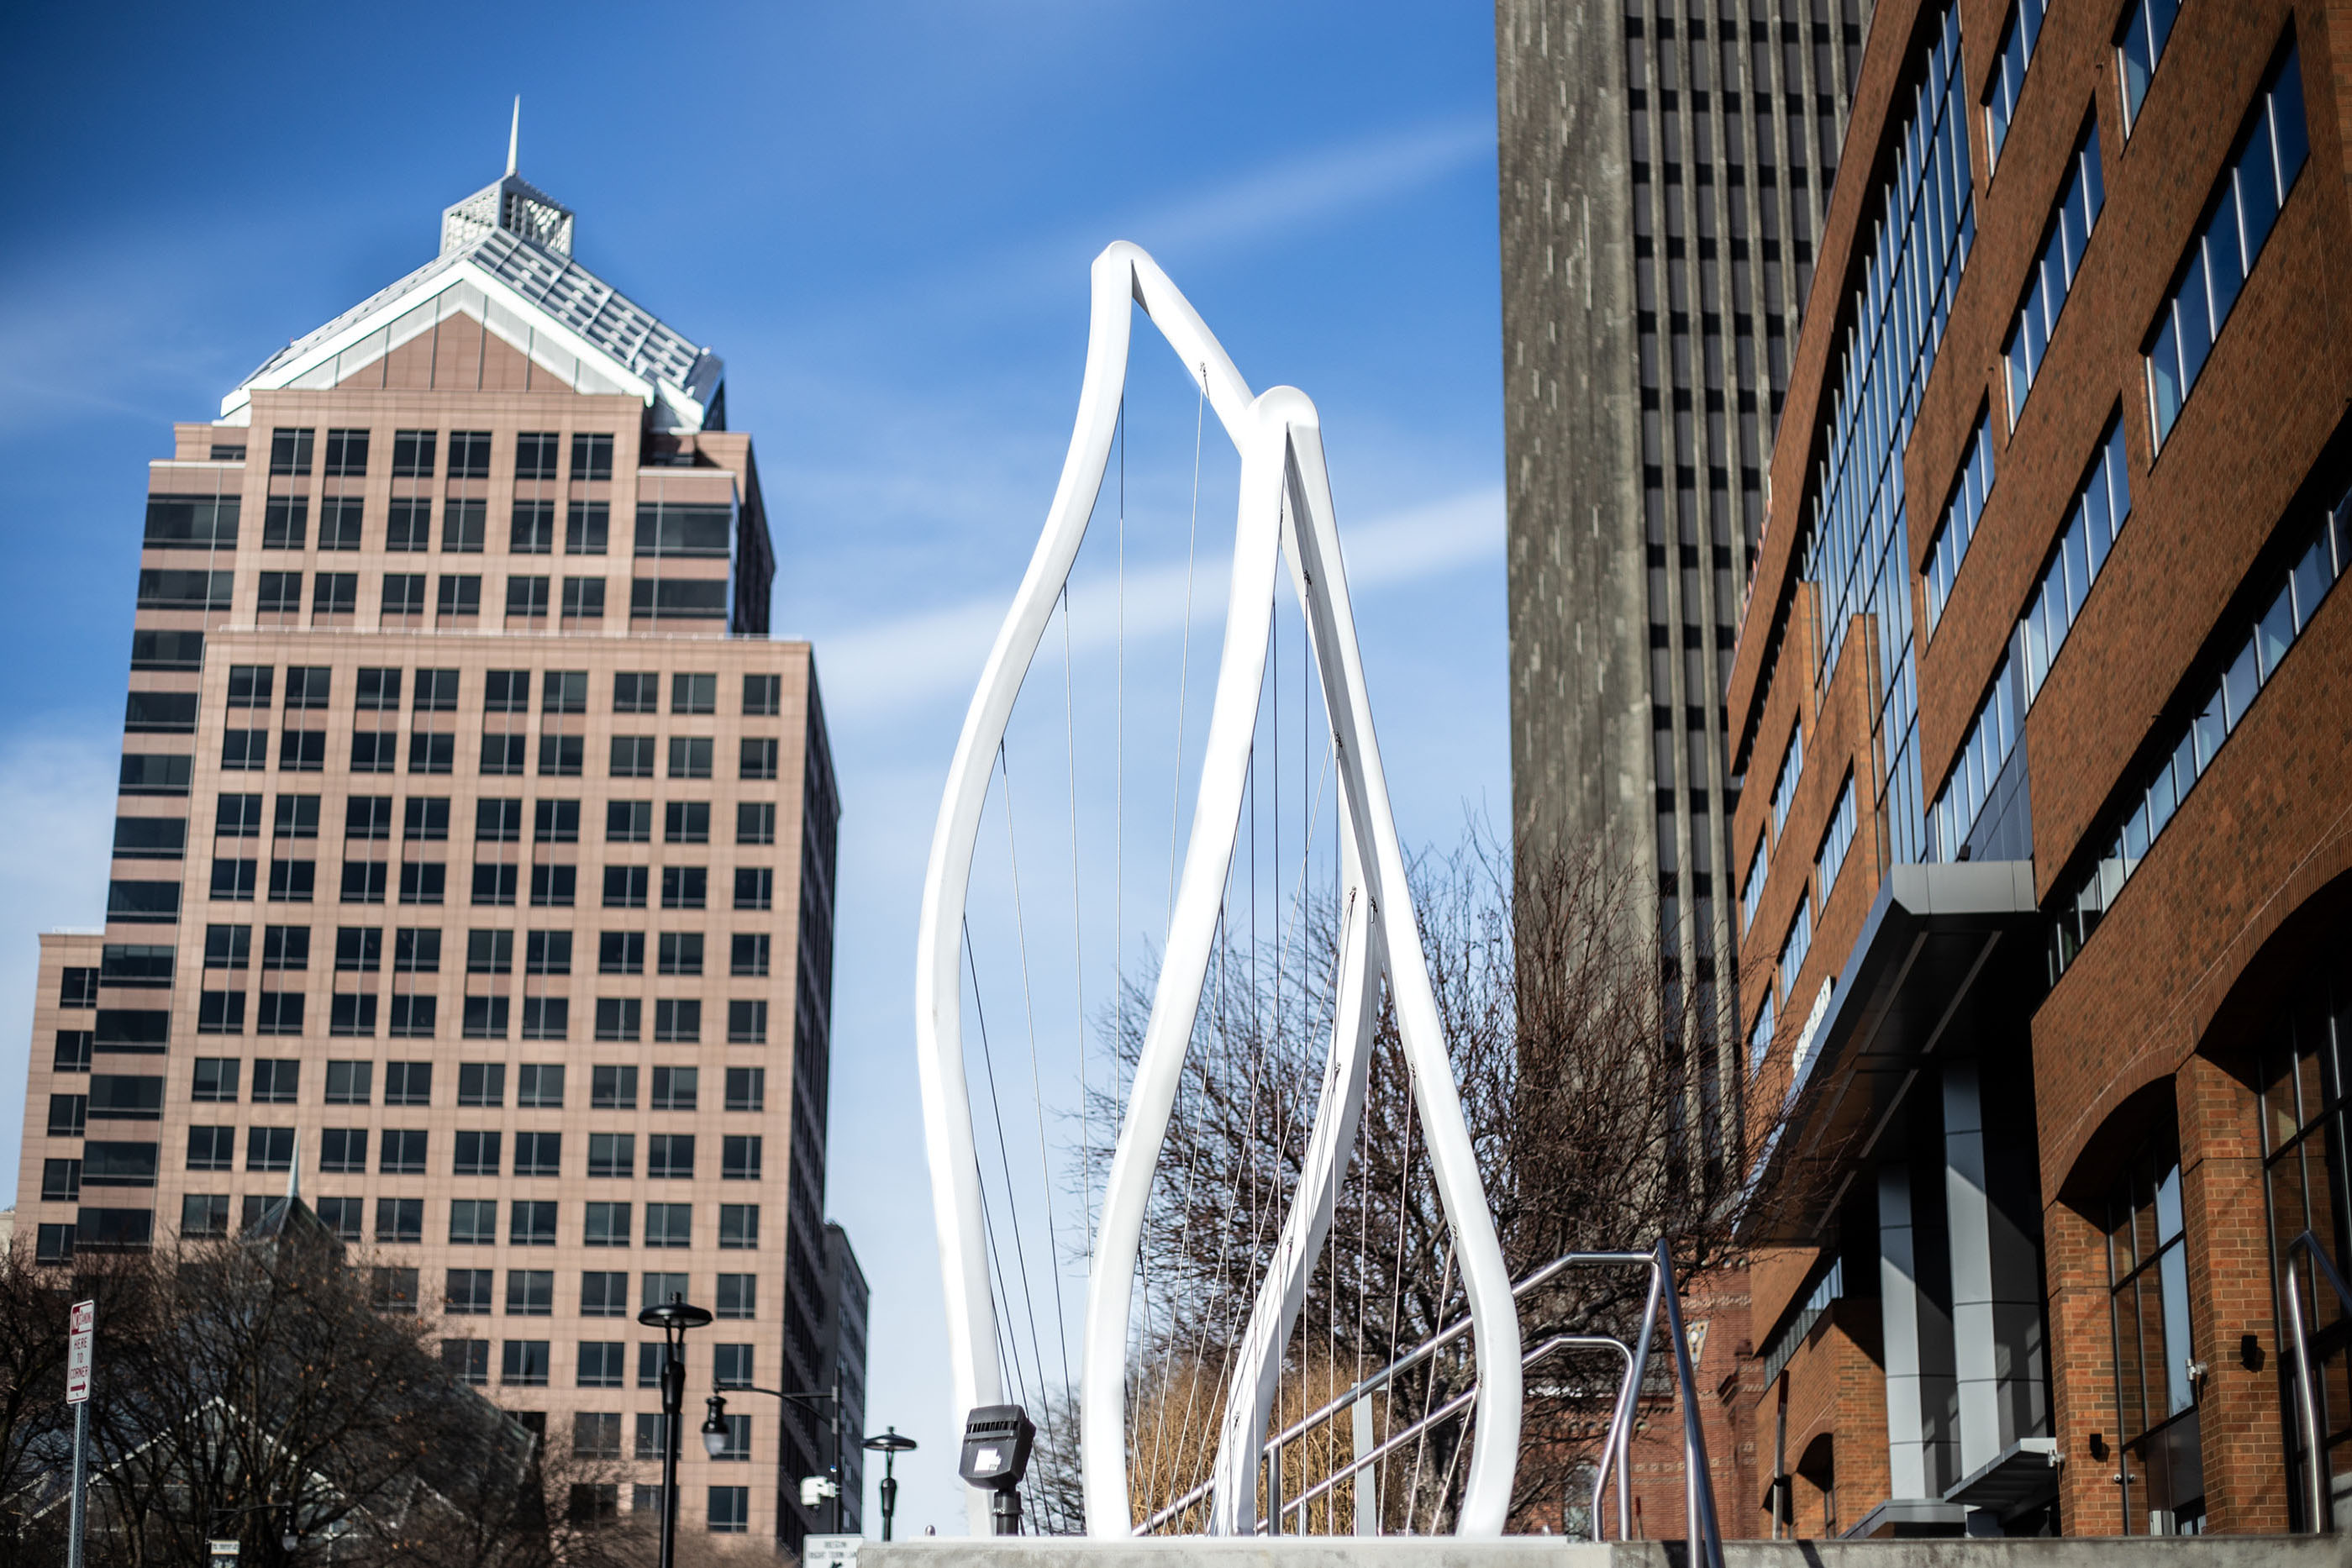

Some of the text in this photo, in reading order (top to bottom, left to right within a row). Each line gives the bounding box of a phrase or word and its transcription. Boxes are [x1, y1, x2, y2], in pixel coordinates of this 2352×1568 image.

[74, 1337, 87, 1350] HERE
[77, 1352, 83, 1364] TO
[71, 1365, 88, 1380] CORNER
